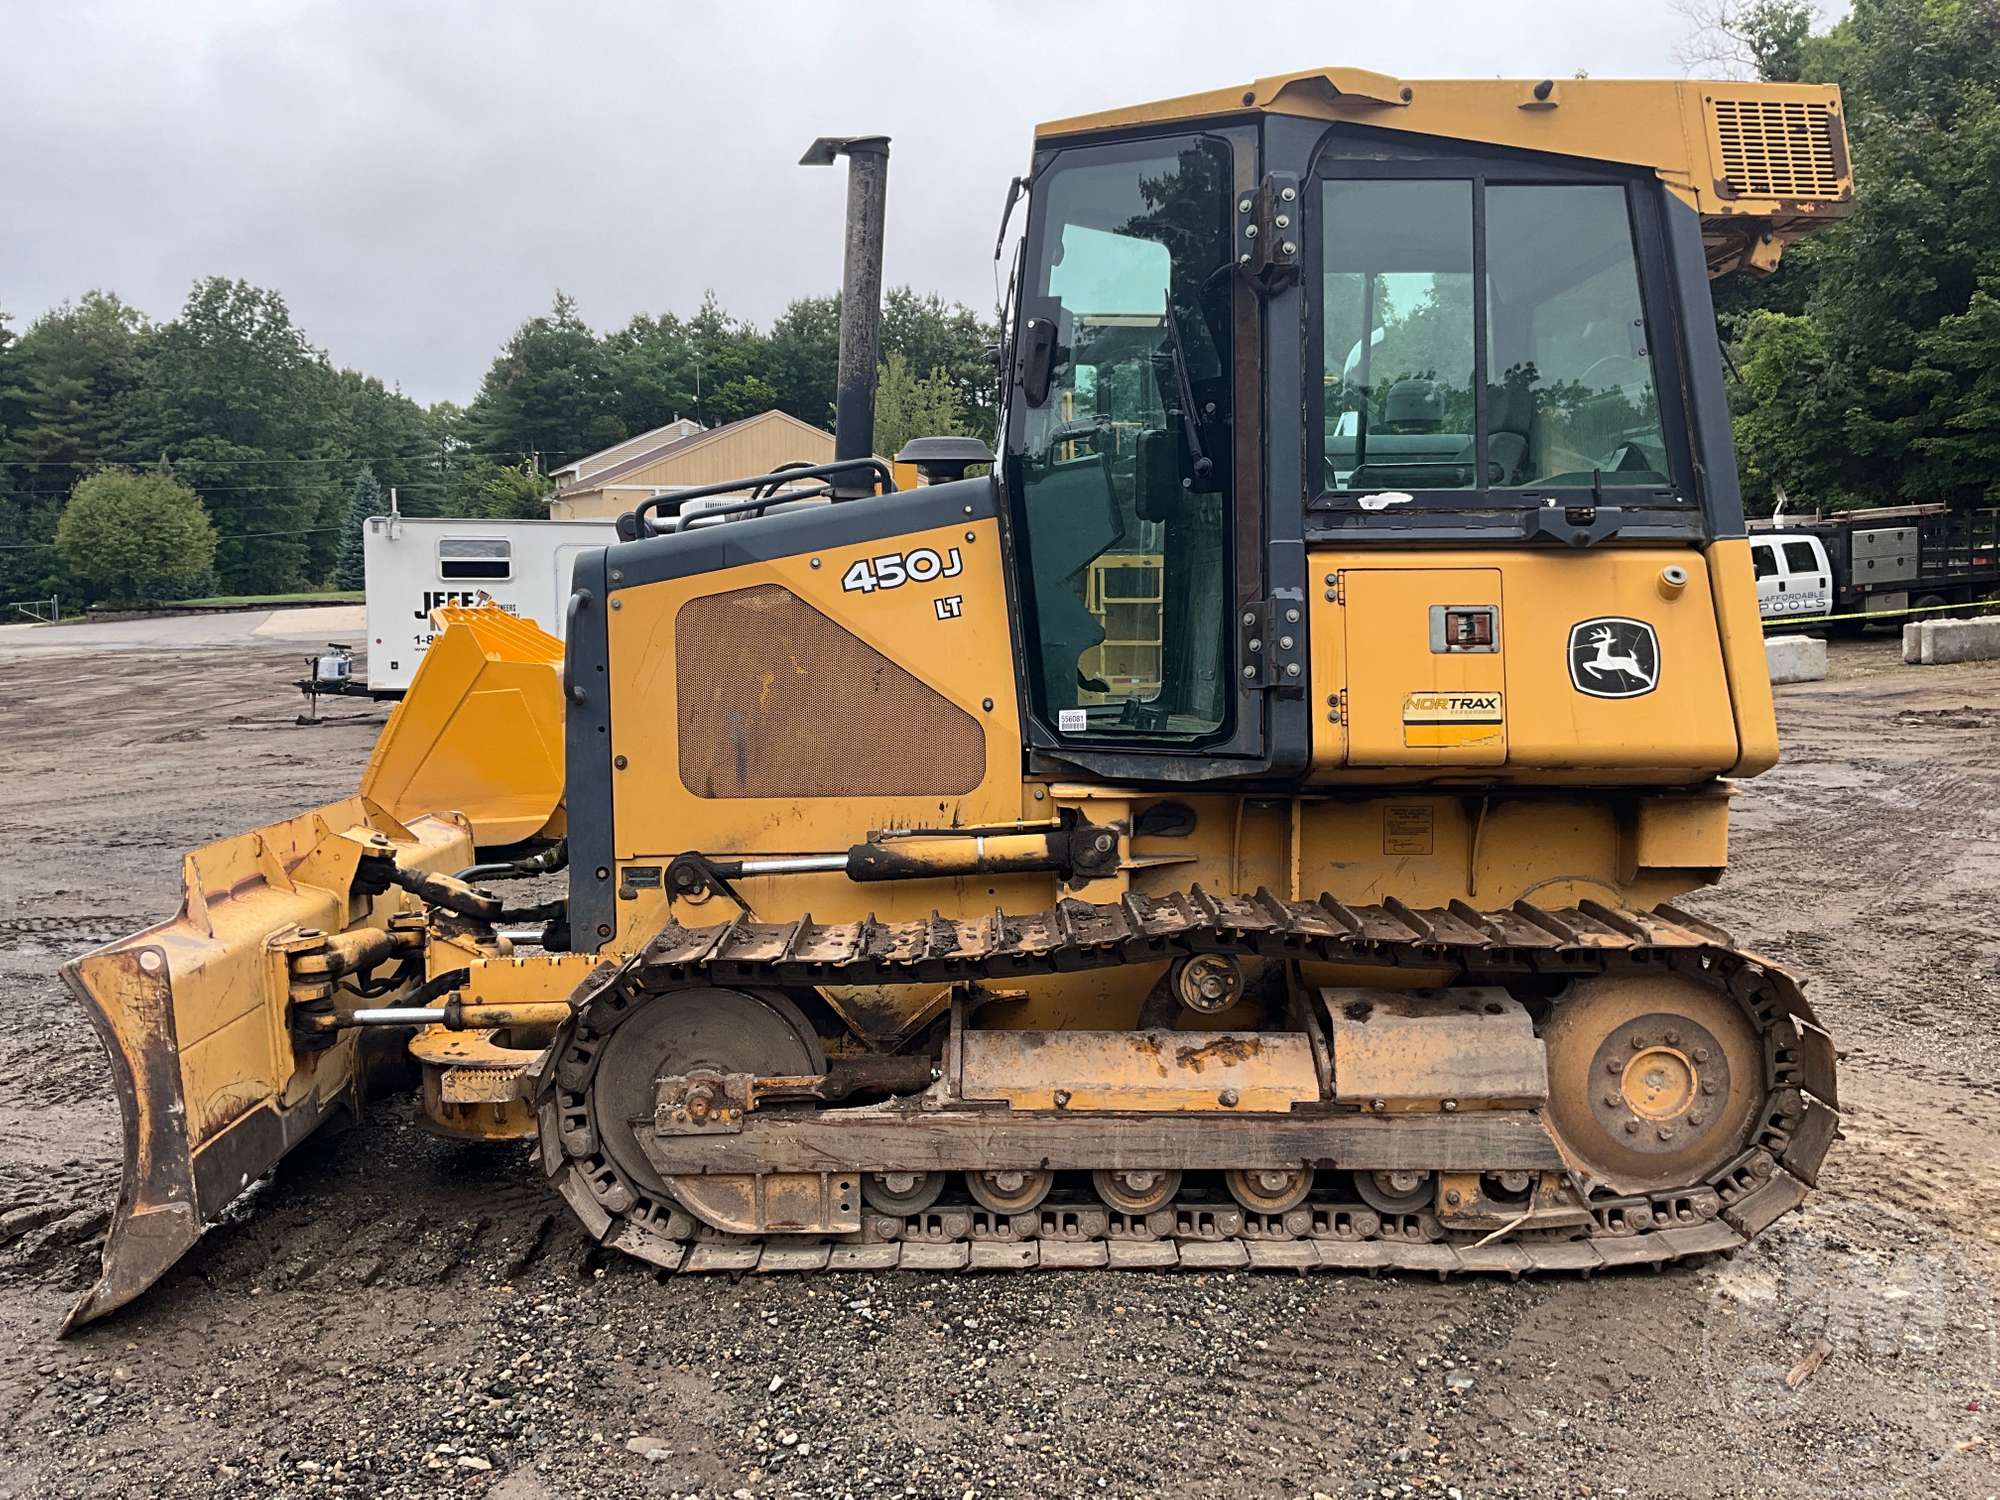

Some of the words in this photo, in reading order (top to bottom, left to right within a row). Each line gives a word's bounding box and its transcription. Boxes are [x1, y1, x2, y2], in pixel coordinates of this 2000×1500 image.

[841, 547, 963, 594] 450J
[1764, 591, 1825, 602] AFFORDABLE
[934, 595, 963, 620] LT
[1760, 598, 1826, 612] POOLS
[1405, 697, 1497, 711] NORTRAX
[1061, 715, 1084, 723] 556081
